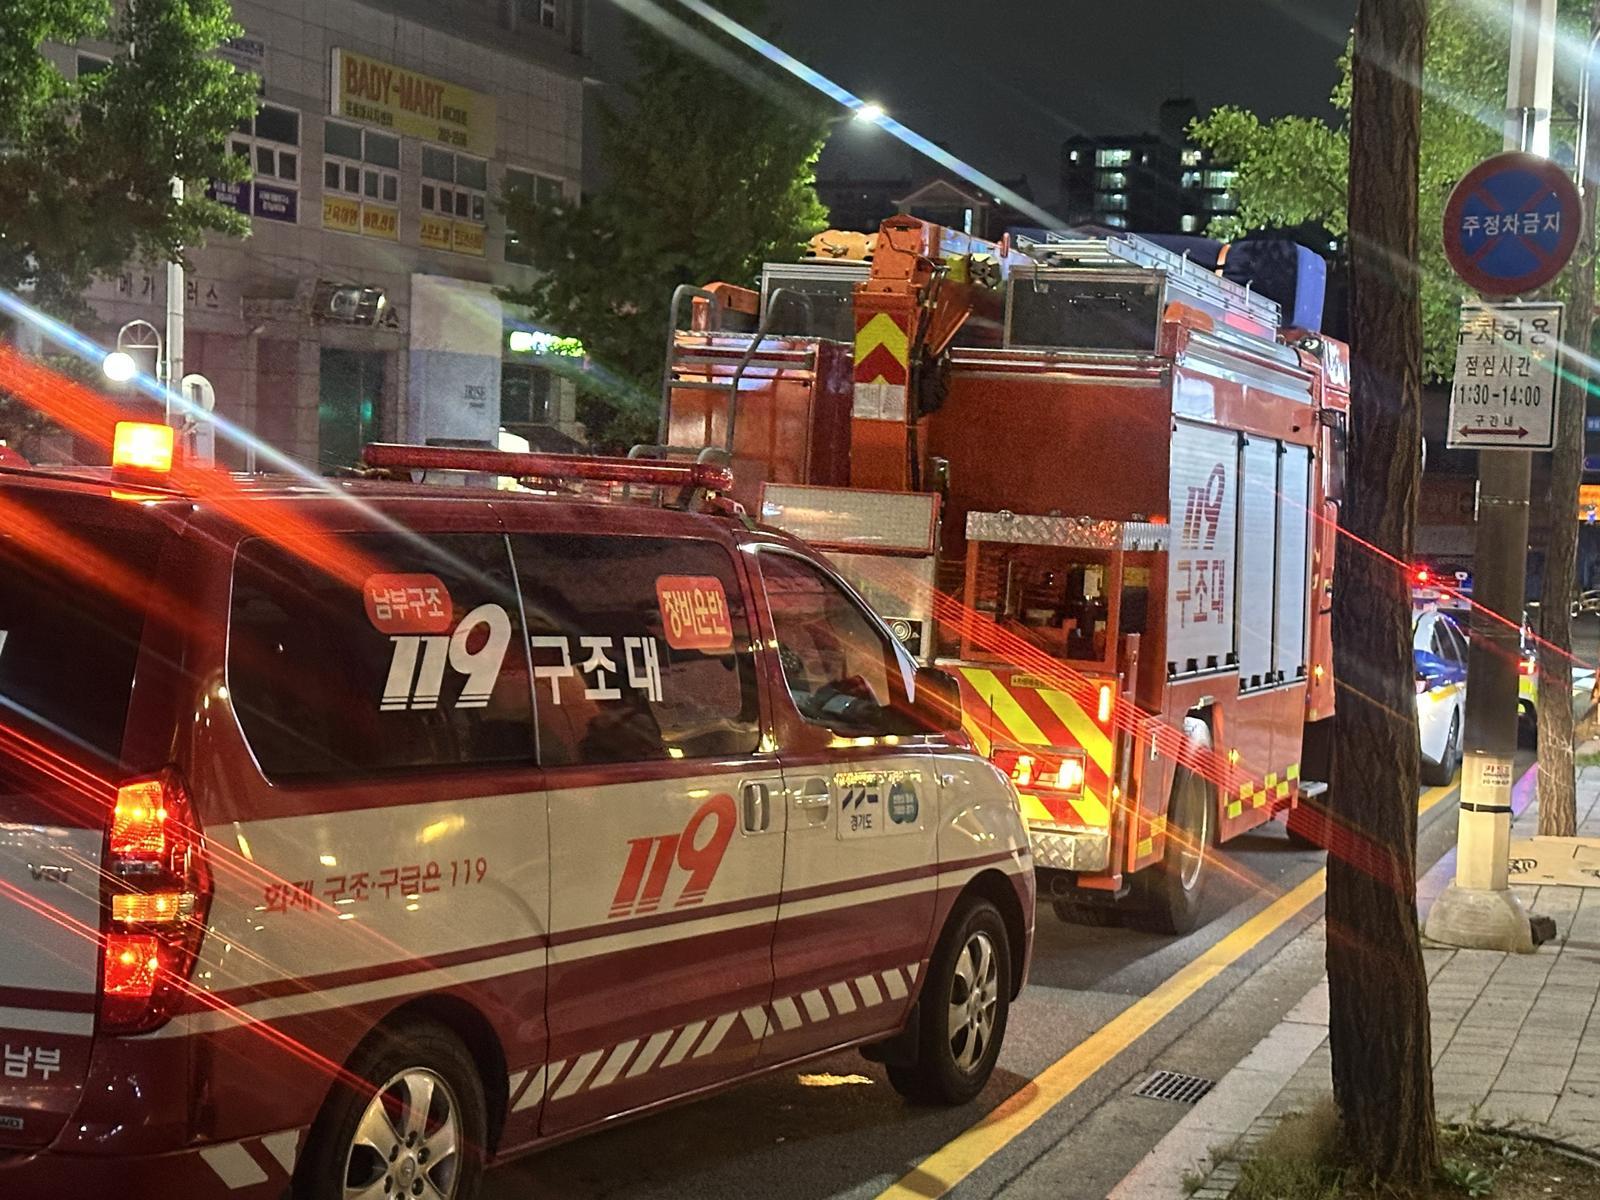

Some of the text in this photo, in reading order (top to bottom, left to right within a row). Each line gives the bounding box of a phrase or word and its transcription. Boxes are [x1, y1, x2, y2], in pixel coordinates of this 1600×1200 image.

[1462, 212, 1561, 238] 주정차금지
[1465, 355, 1531, 377] 점심시간
[1181, 462, 1225, 550] 119
[372, 588, 445, 620] 남부구조
[1176, 559, 1225, 629] 구조대
[662, 588, 728, 638] 장비운반
[380, 603, 664, 711] 119 구조대
[850, 813, 872, 831] 경기도
[451, 857, 488, 887] 119
[607, 793, 737, 919] 119
[4, 1044, 61, 1081] 남부
